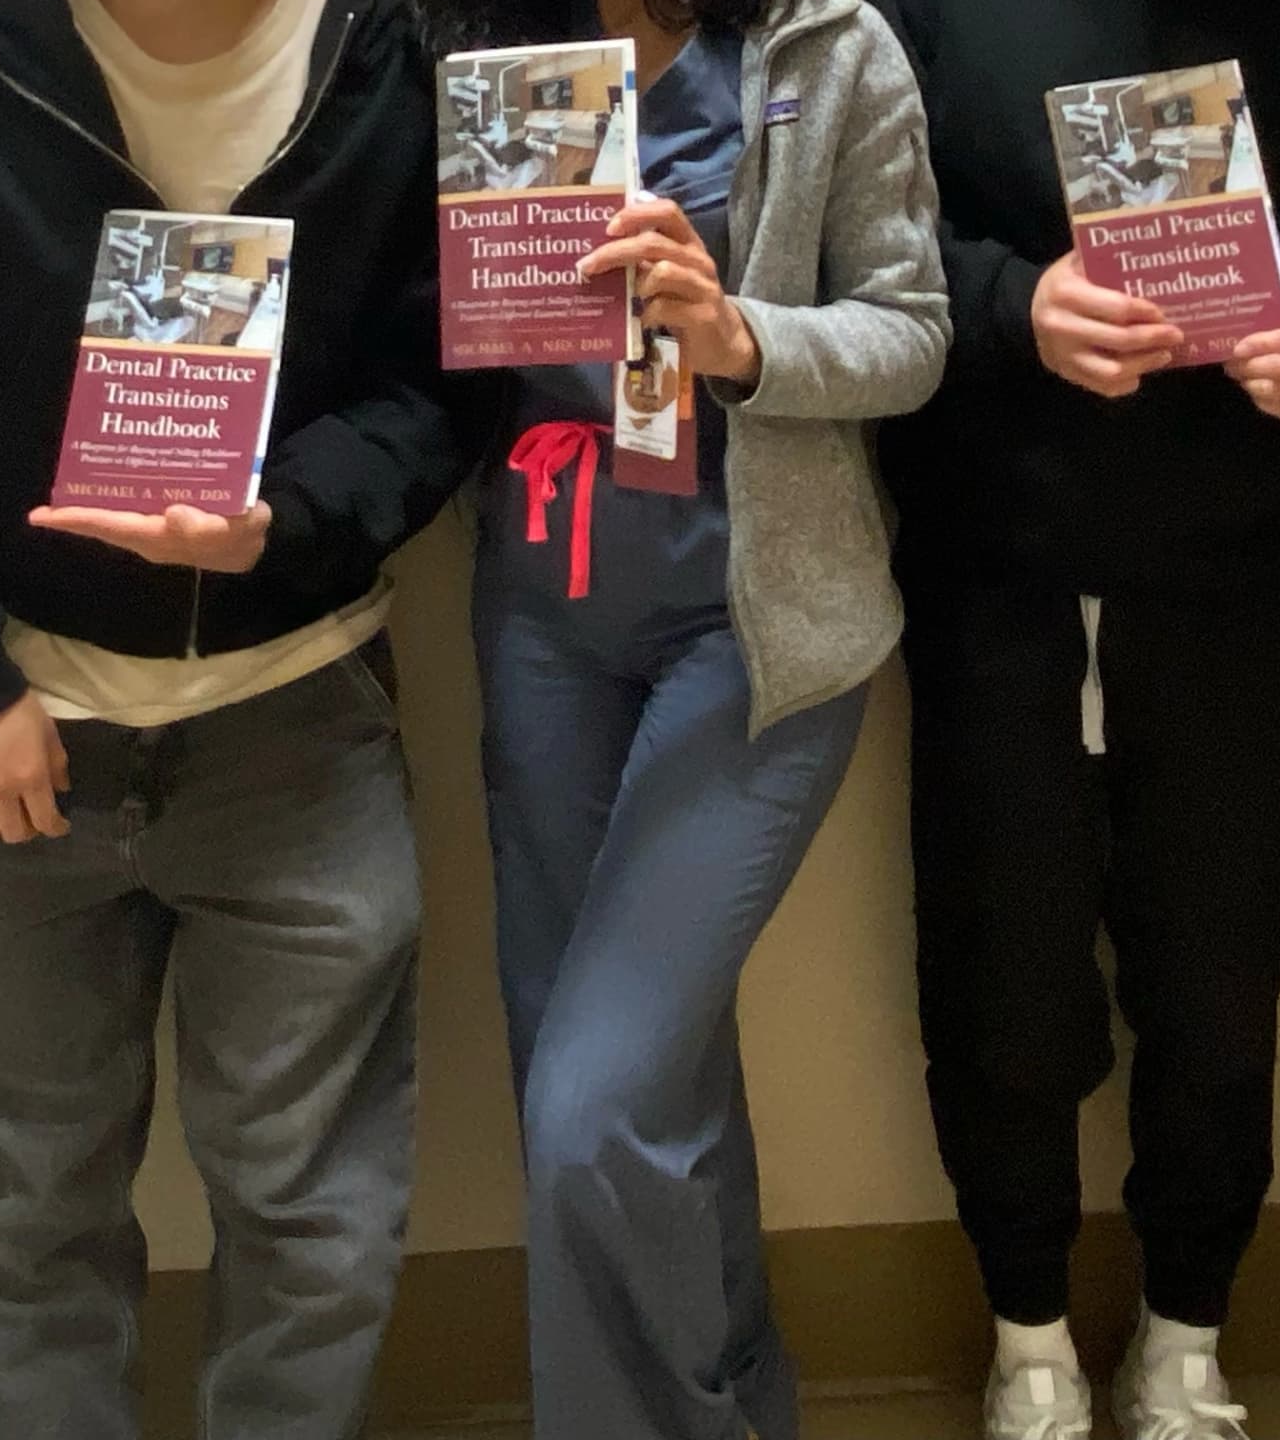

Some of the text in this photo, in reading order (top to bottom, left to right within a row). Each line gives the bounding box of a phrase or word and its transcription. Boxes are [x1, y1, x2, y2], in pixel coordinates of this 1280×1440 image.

[448, 202, 615, 229] Dental Practice
[1088, 206, 1256, 246] Dental Practice
[467, 236, 592, 258] Transitions
[1113, 238, 1240, 271] Transitions
[1123, 264, 1245, 297] Handbook
[85, 351, 256, 382] Dental Practice
[104, 381, 229, 409] Transitions
[99, 411, 221, 439] Handbook
